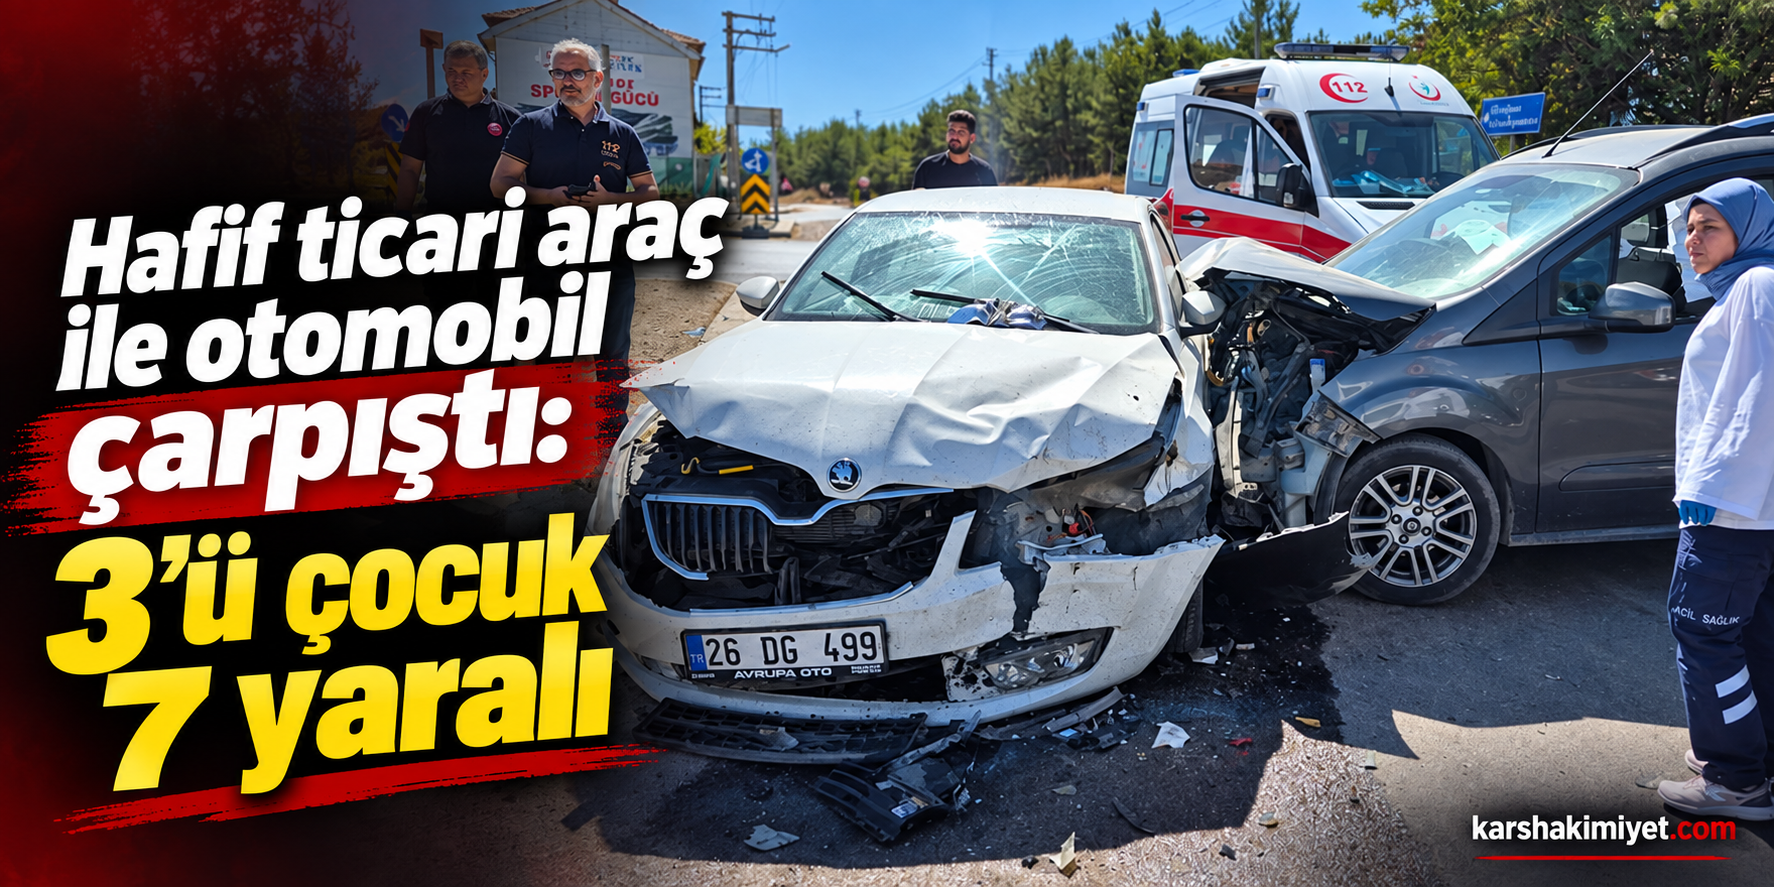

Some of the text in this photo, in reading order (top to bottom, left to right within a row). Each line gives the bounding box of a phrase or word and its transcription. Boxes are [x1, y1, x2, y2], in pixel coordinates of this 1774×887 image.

[1332, 80, 1368, 94] 112
[611, 89, 659, 107] GÜCÜ
[1702, 613, 1740, 626] SAĞLIK
[705, 631, 878, 667] 26 DG 499
[690, 653, 705, 664] TR
[734, 667, 833, 680] AVRUPA OTO
